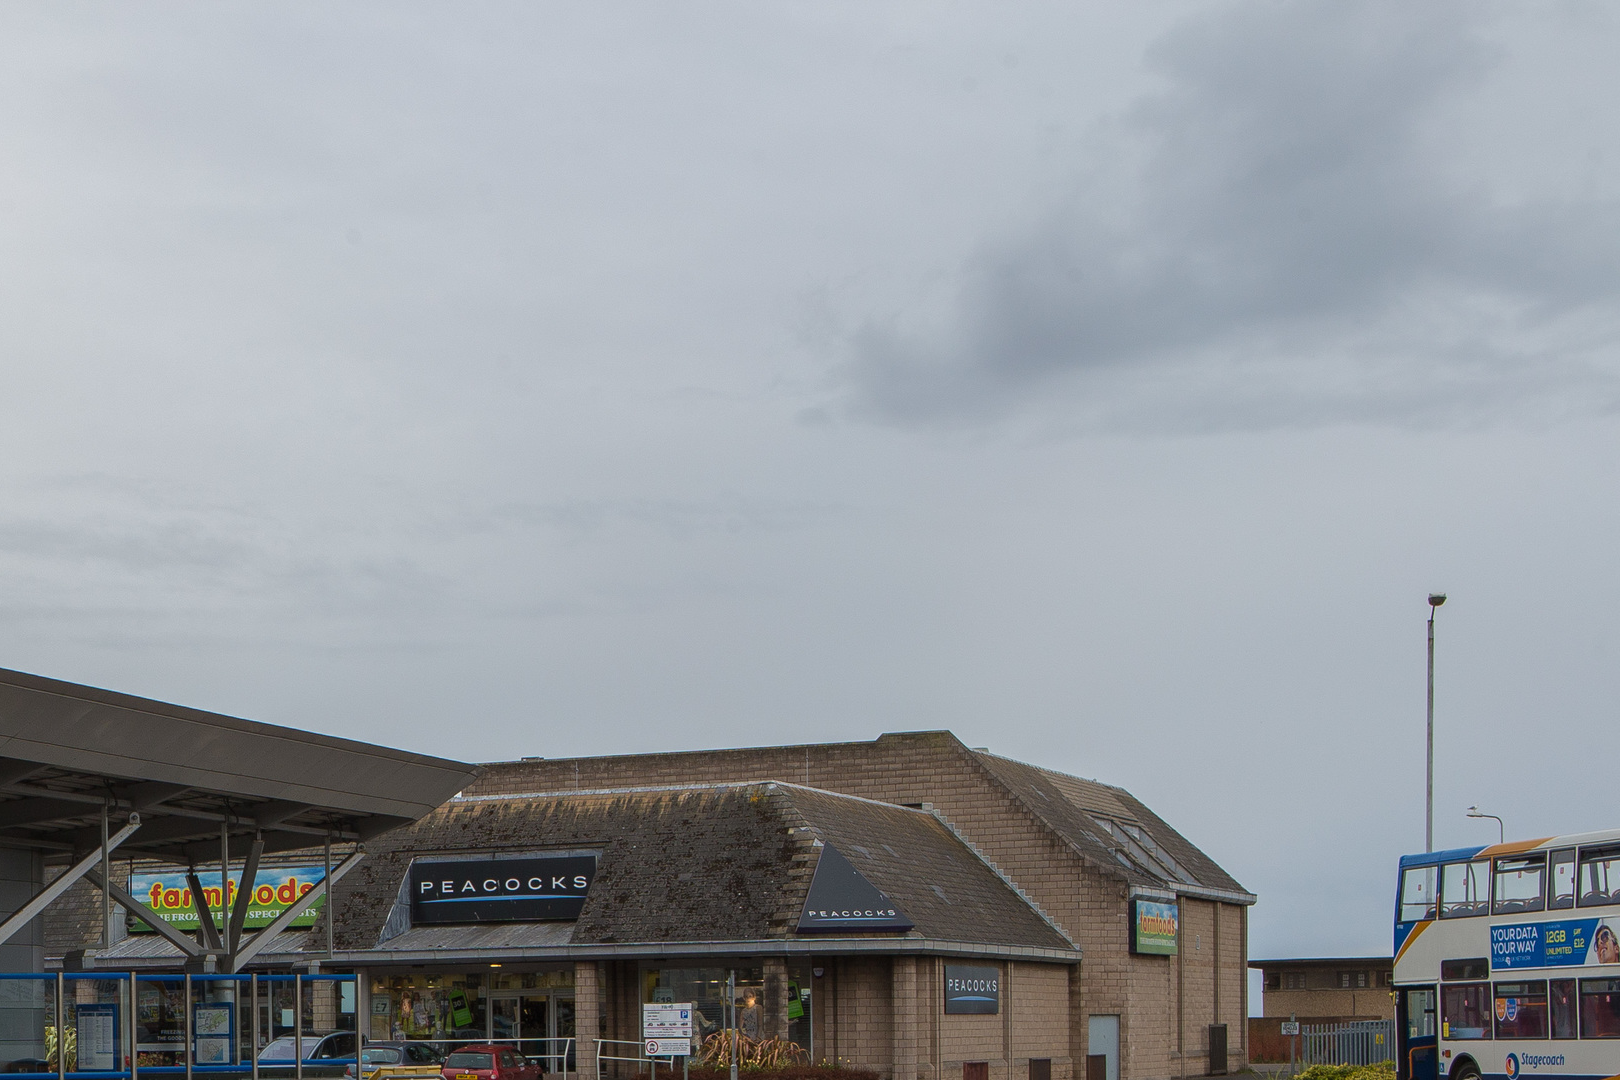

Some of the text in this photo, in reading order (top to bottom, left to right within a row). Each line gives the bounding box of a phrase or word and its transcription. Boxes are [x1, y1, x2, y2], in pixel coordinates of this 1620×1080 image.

[420, 876, 588, 893] PEACOCKS
[808, 909, 897, 918] PEACOCKS
[1140, 909, 1176, 936] farmfoods
[1492, 926, 1538, 941] YOUR DATA
[1545, 930, 1566, 943] 12GB
[1492, 940, 1536, 955] YOUR WAY
[1574, 938, 1585, 948] £12
[1545, 947, 1573, 955] UNLIMITED
[948, 978, 997, 992] PEACOCKS
[375, 1002, 388, 1012] £7
[1521, 1052, 1565, 1070] Stagecoach
